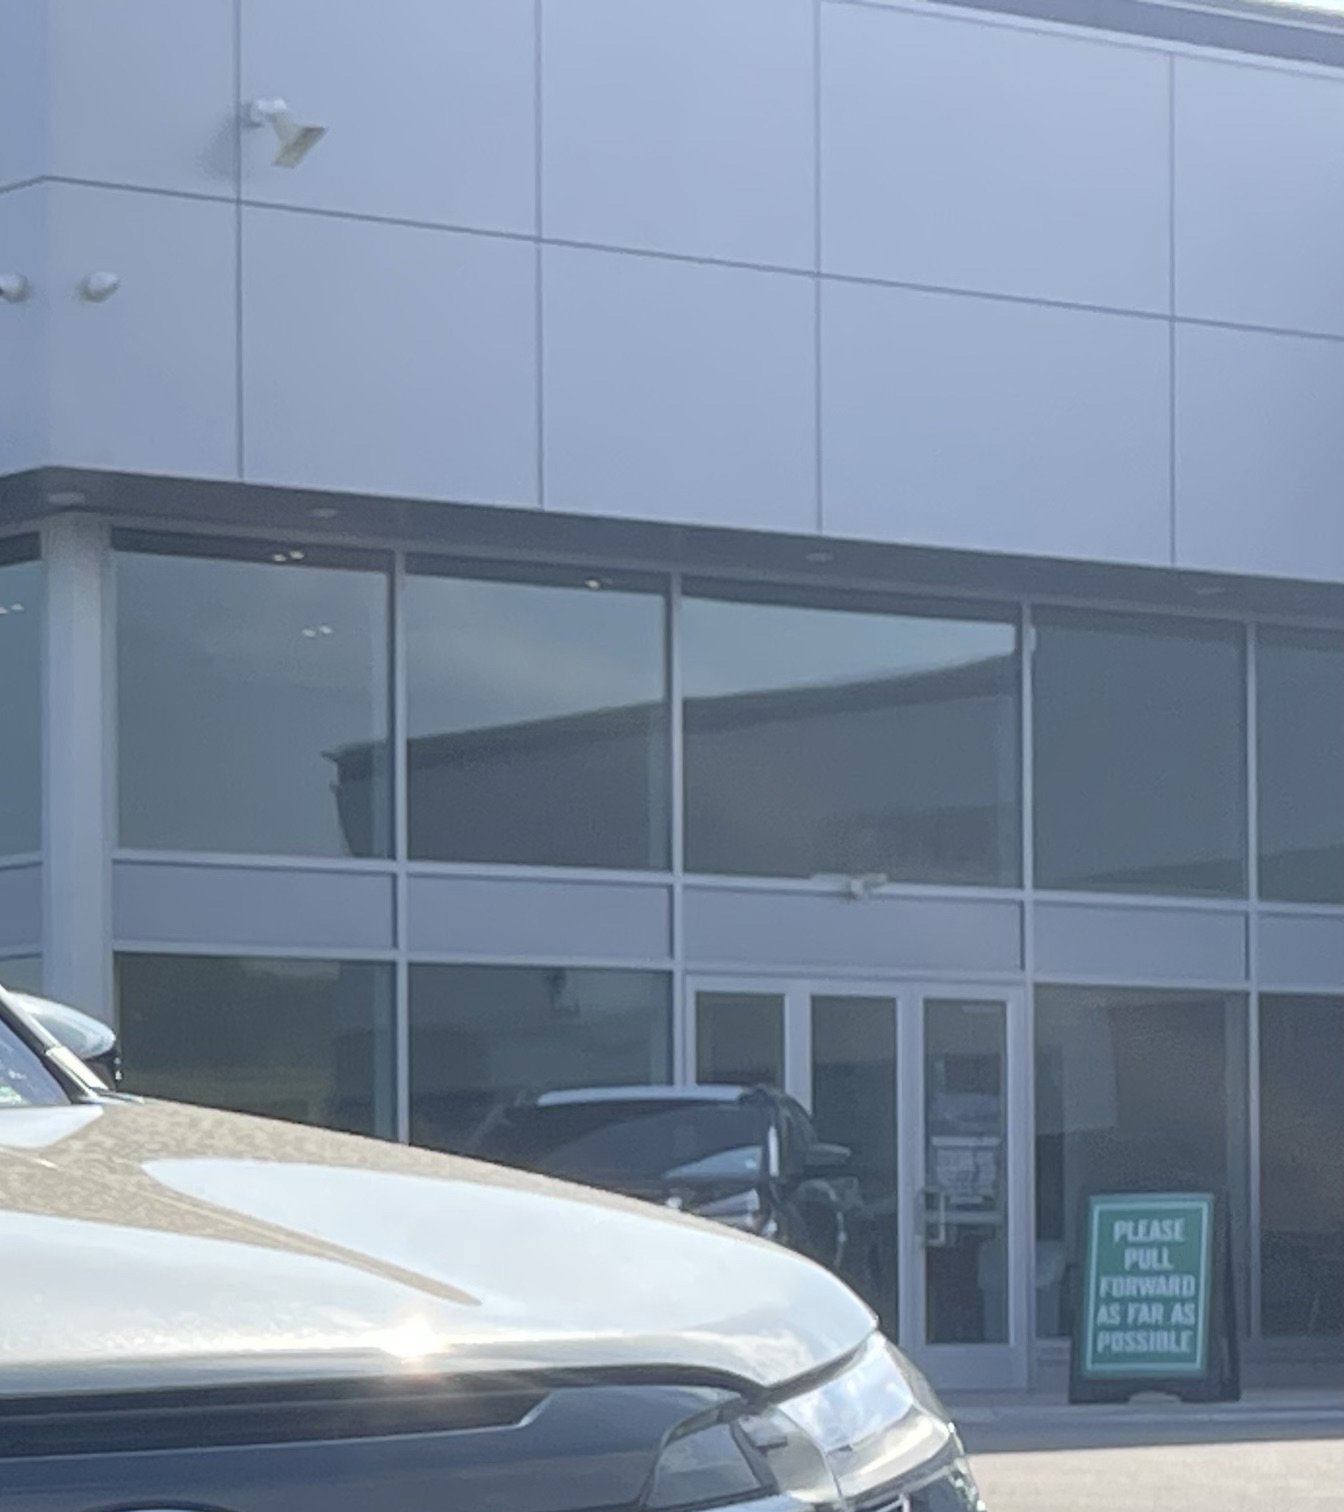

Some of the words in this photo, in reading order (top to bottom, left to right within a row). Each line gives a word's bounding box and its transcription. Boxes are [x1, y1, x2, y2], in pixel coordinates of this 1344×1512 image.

[1113, 1218, 1185, 1242] PLEASE
[1123, 1247, 1173, 1271] PULL
[1098, 1275, 1195, 1299] FORWARD
[1096, 1303, 1120, 1326] AS
[1127, 1303, 1164, 1326] FAR
[1170, 1302, 1195, 1325] AS
[1096, 1330, 1194, 1354] POSSIBLE
